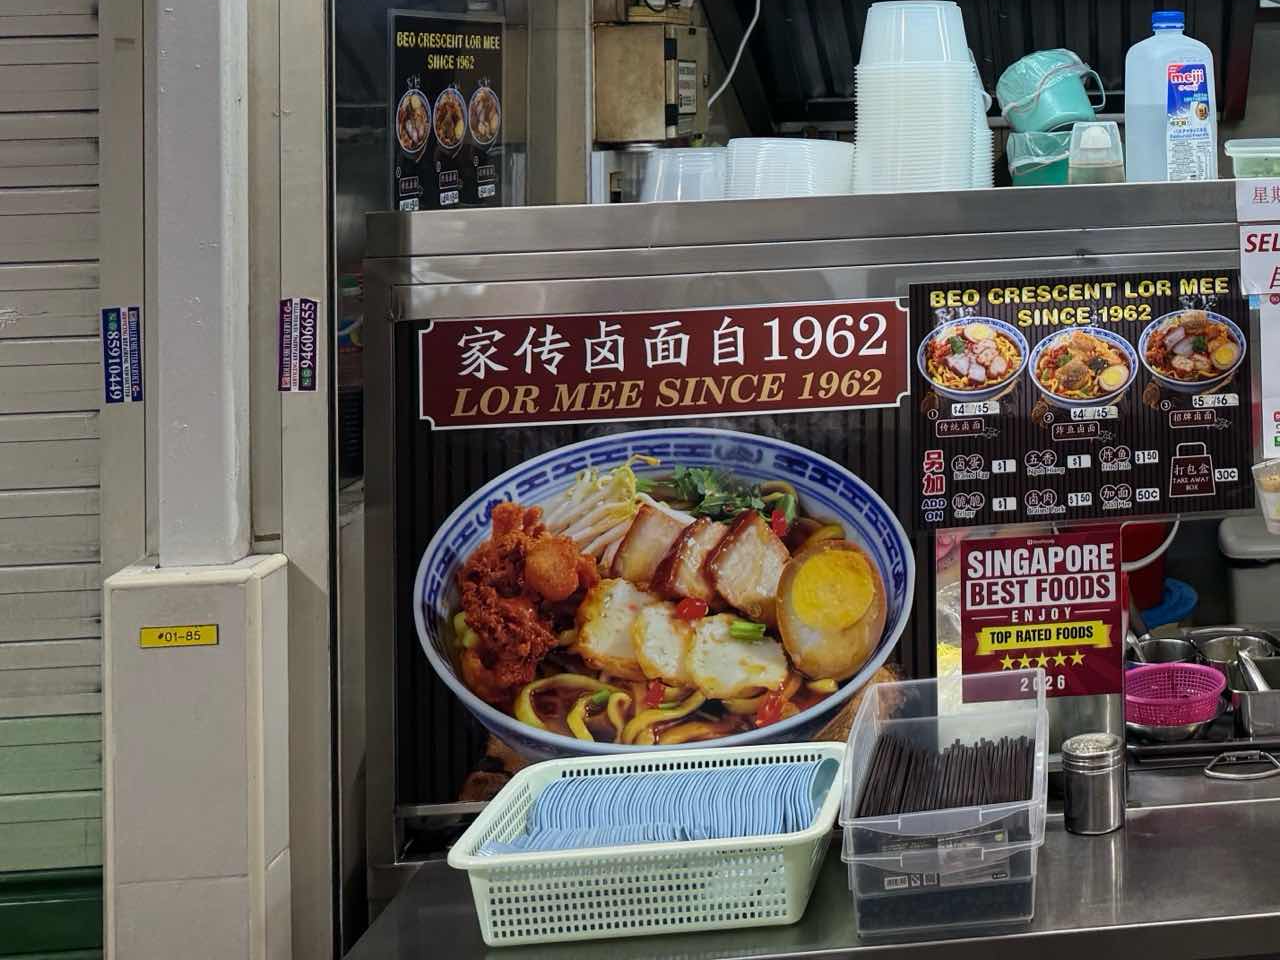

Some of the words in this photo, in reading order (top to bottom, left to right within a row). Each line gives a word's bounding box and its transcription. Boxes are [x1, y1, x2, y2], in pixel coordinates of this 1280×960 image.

[396, 31, 416, 48] BEO
[418, 32, 463, 49] CRESCENT
[464, 34, 482, 49] LOR
[483, 35, 501, 50] MEE
[427, 55, 454, 70] SINCE
[456, 55, 475, 70] 1962
[1171, 69, 1205, 84] meiji
[929, 289, 980, 309] BEO
[987, 282, 1116, 305] CRESCENT
[1124, 279, 1172, 299] LOR
[1180, 277, 1230, 296] MEE
[1017, 307, 1092, 328] SINCE
[1098, 304, 1152, 323] 1962
[301, 302, 314, 368] 94606655
[457, 312, 887, 380] 家传卤面自1962
[107, 331, 121, 399] 85910449
[450, 384, 540, 417] LOR
[549, 379, 644, 414] MEE
[656, 372, 786, 408] SINCE
[797, 368, 883, 399] 1962
[997, 460, 1007, 472] $1
[1028, 451, 1055, 466] 五香
[1072, 455, 1082, 467] $1
[922, 449, 946, 496] 另加
[921, 498, 947, 510] ADD
[998, 497, 1008, 510] $1
[925, 511, 944, 522] ON
[967, 543, 1114, 579] SINGAPORE
[970, 580, 1029, 607] BEST
[1036, 574, 1111, 603] FOODS
[1011, 607, 1072, 623] ENJOY
[990, 631, 1012, 644] TOP
[1016, 628, 1051, 643] RATED
[1056, 625, 1094, 640] FOODS
